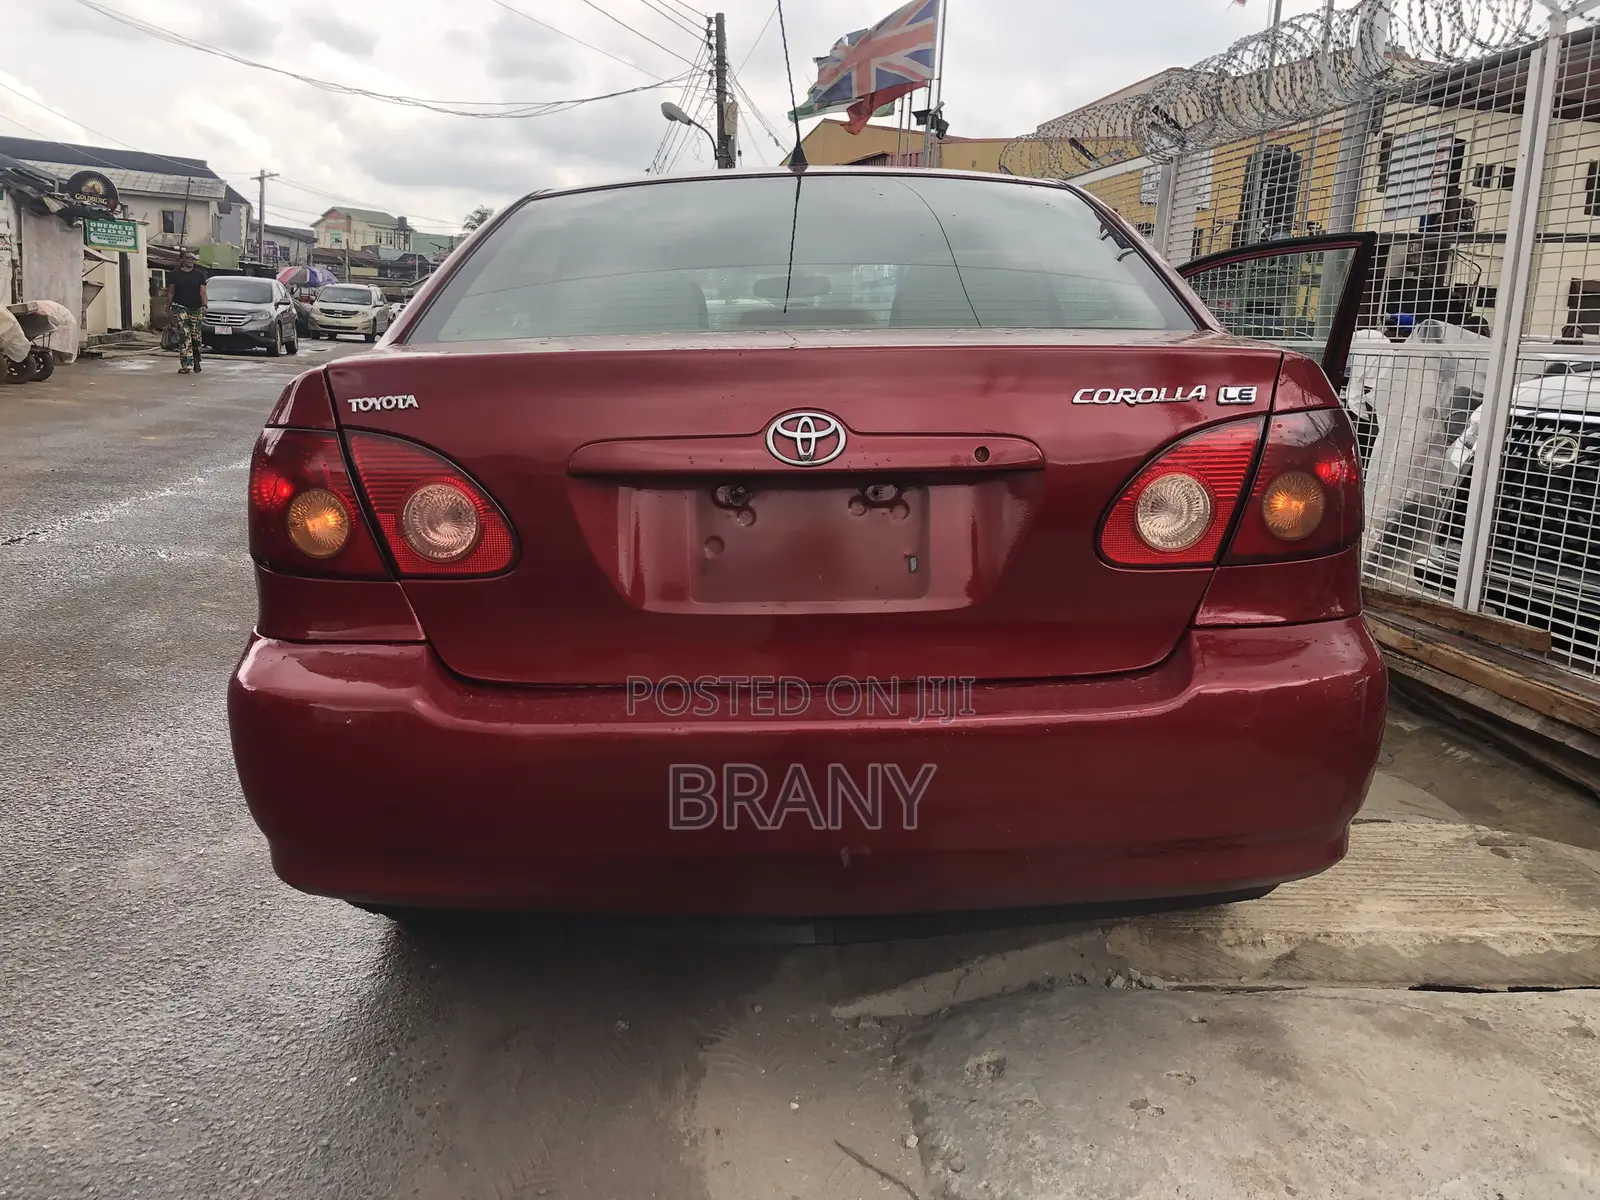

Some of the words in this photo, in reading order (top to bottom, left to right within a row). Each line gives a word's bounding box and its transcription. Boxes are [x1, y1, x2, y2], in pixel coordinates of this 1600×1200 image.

[347, 394, 419, 413] TOYOTA
[1072, 385, 1206, 405] COROLLA
[1220, 387, 1256, 402] LE
